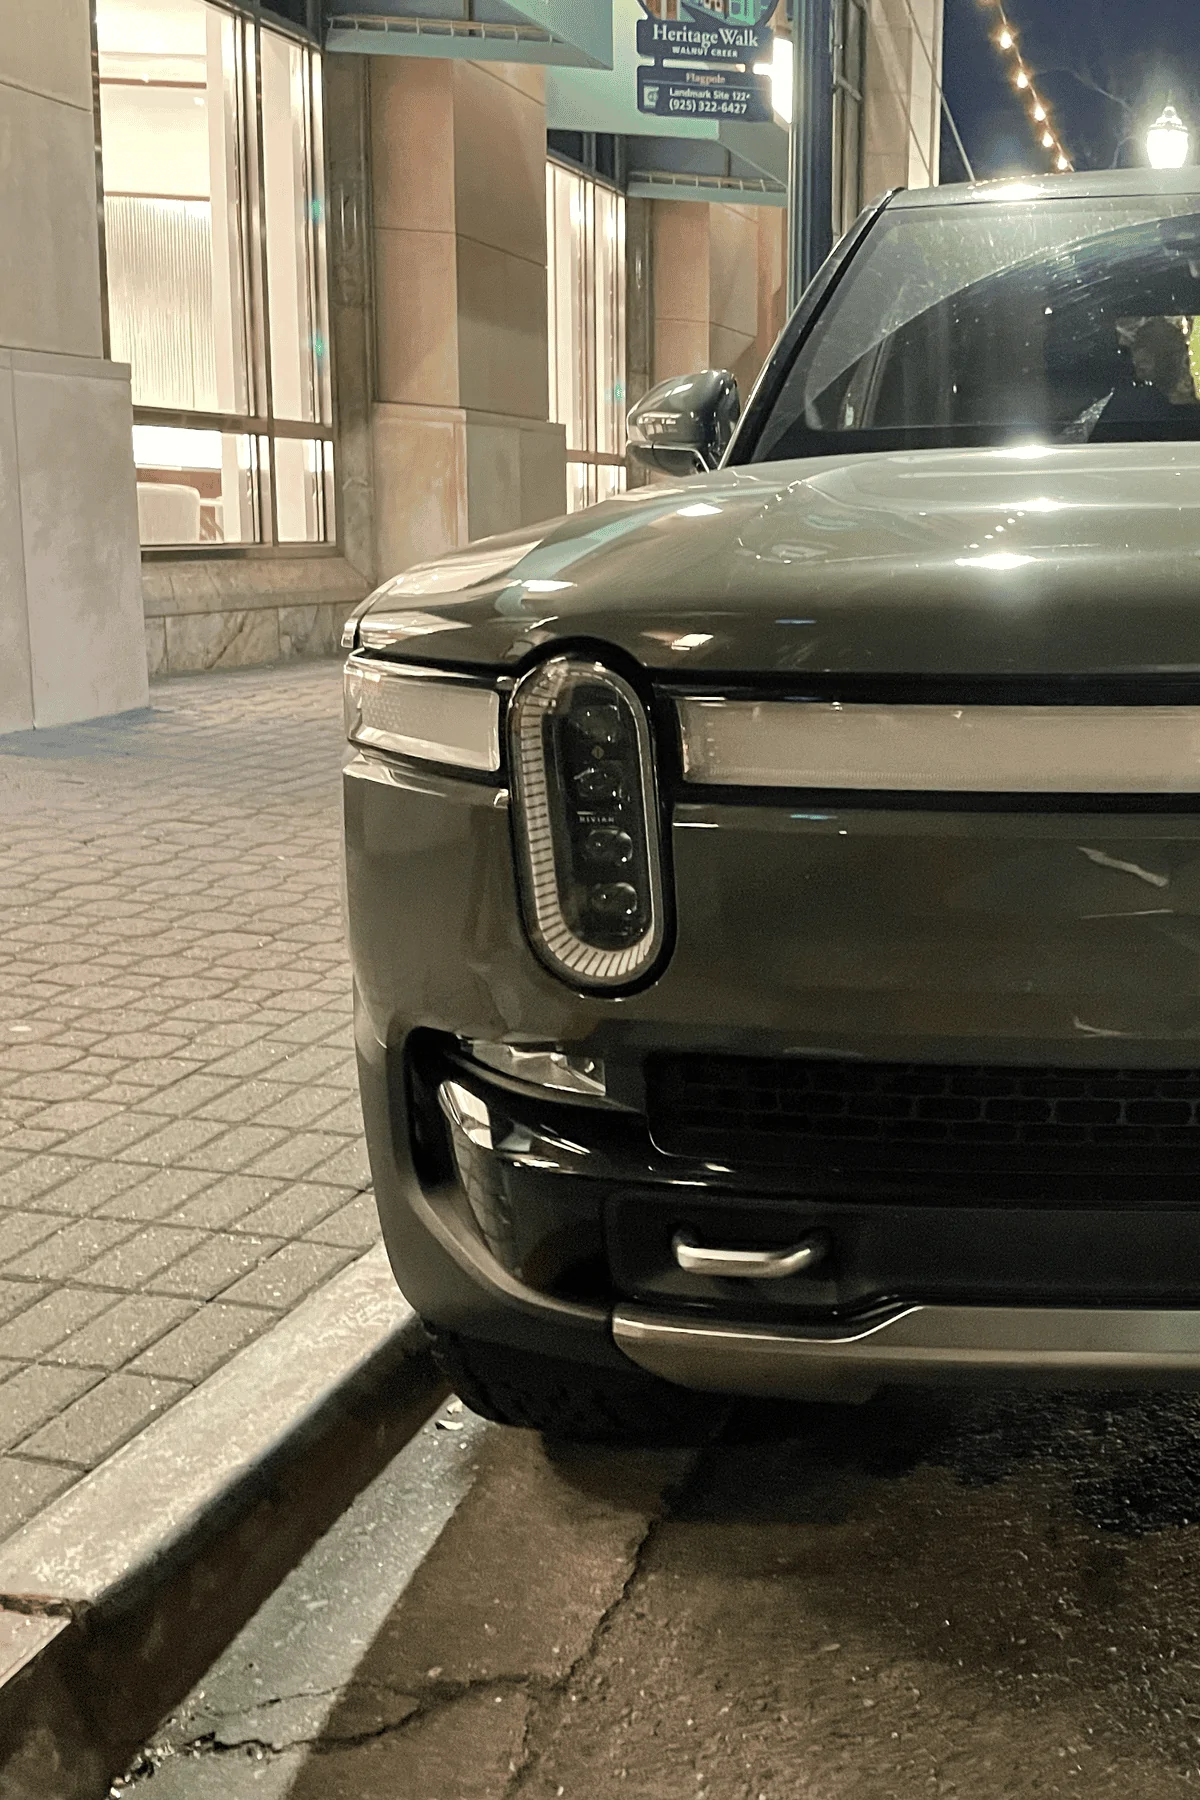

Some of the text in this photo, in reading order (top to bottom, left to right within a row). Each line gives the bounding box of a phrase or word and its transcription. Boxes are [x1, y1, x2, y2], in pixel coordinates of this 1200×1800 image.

[653, 24, 758, 48] Heritage Walk
[672, 46, 738, 57] WALNUT CREEK
[686, 73, 725, 85] Flagpole
[669, 87, 711, 98] Landmark
[713, 90, 730, 100] Site
[669, 98, 747, 114] (925) 322-6427
